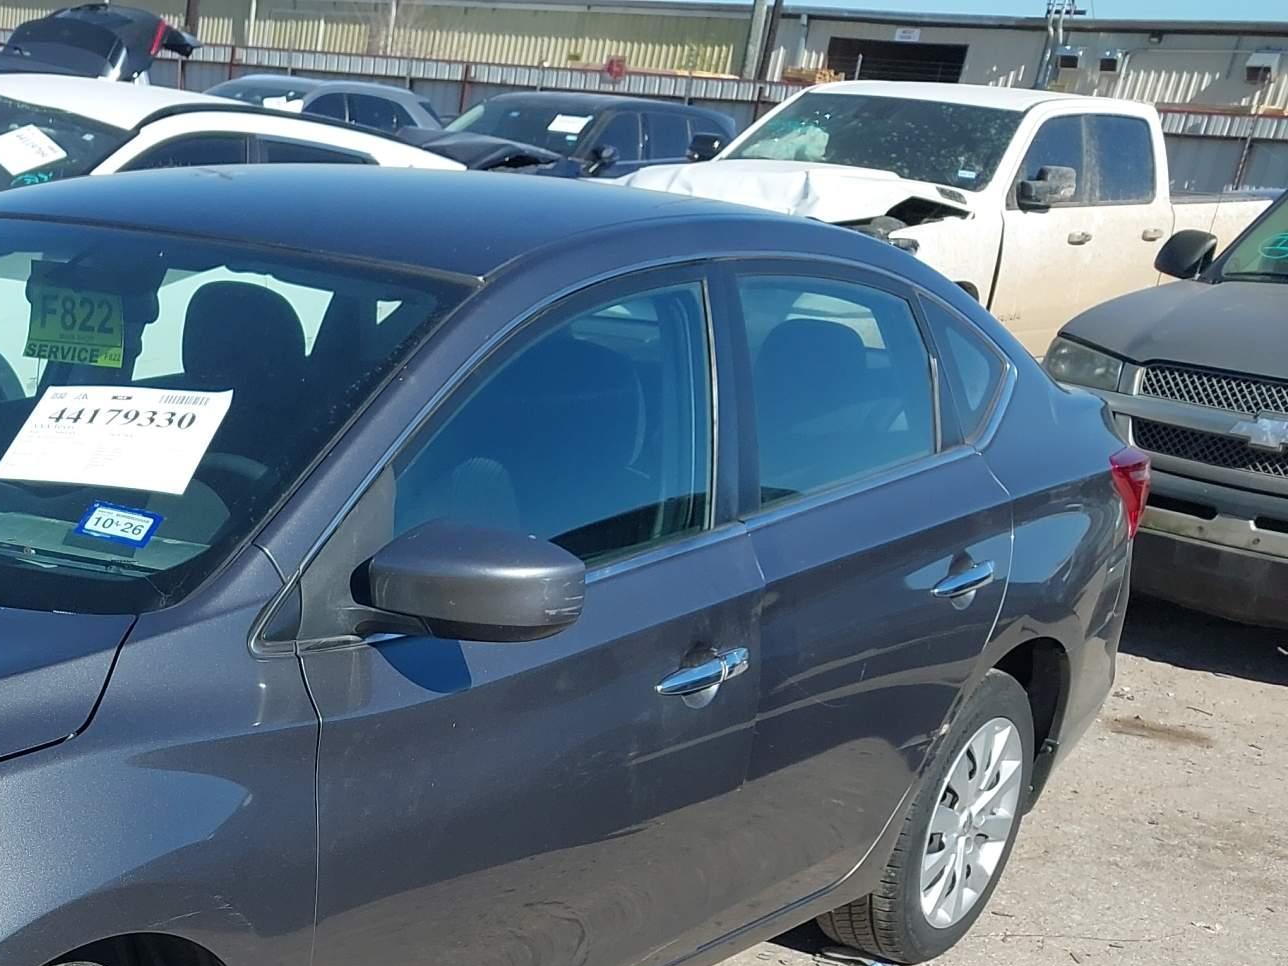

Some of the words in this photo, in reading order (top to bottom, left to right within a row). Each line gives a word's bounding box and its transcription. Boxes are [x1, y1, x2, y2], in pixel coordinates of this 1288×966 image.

[39, 293, 115, 335] F822
[25, 342, 100, 363] SERVICE
[48, 408, 196, 430] 44179330
